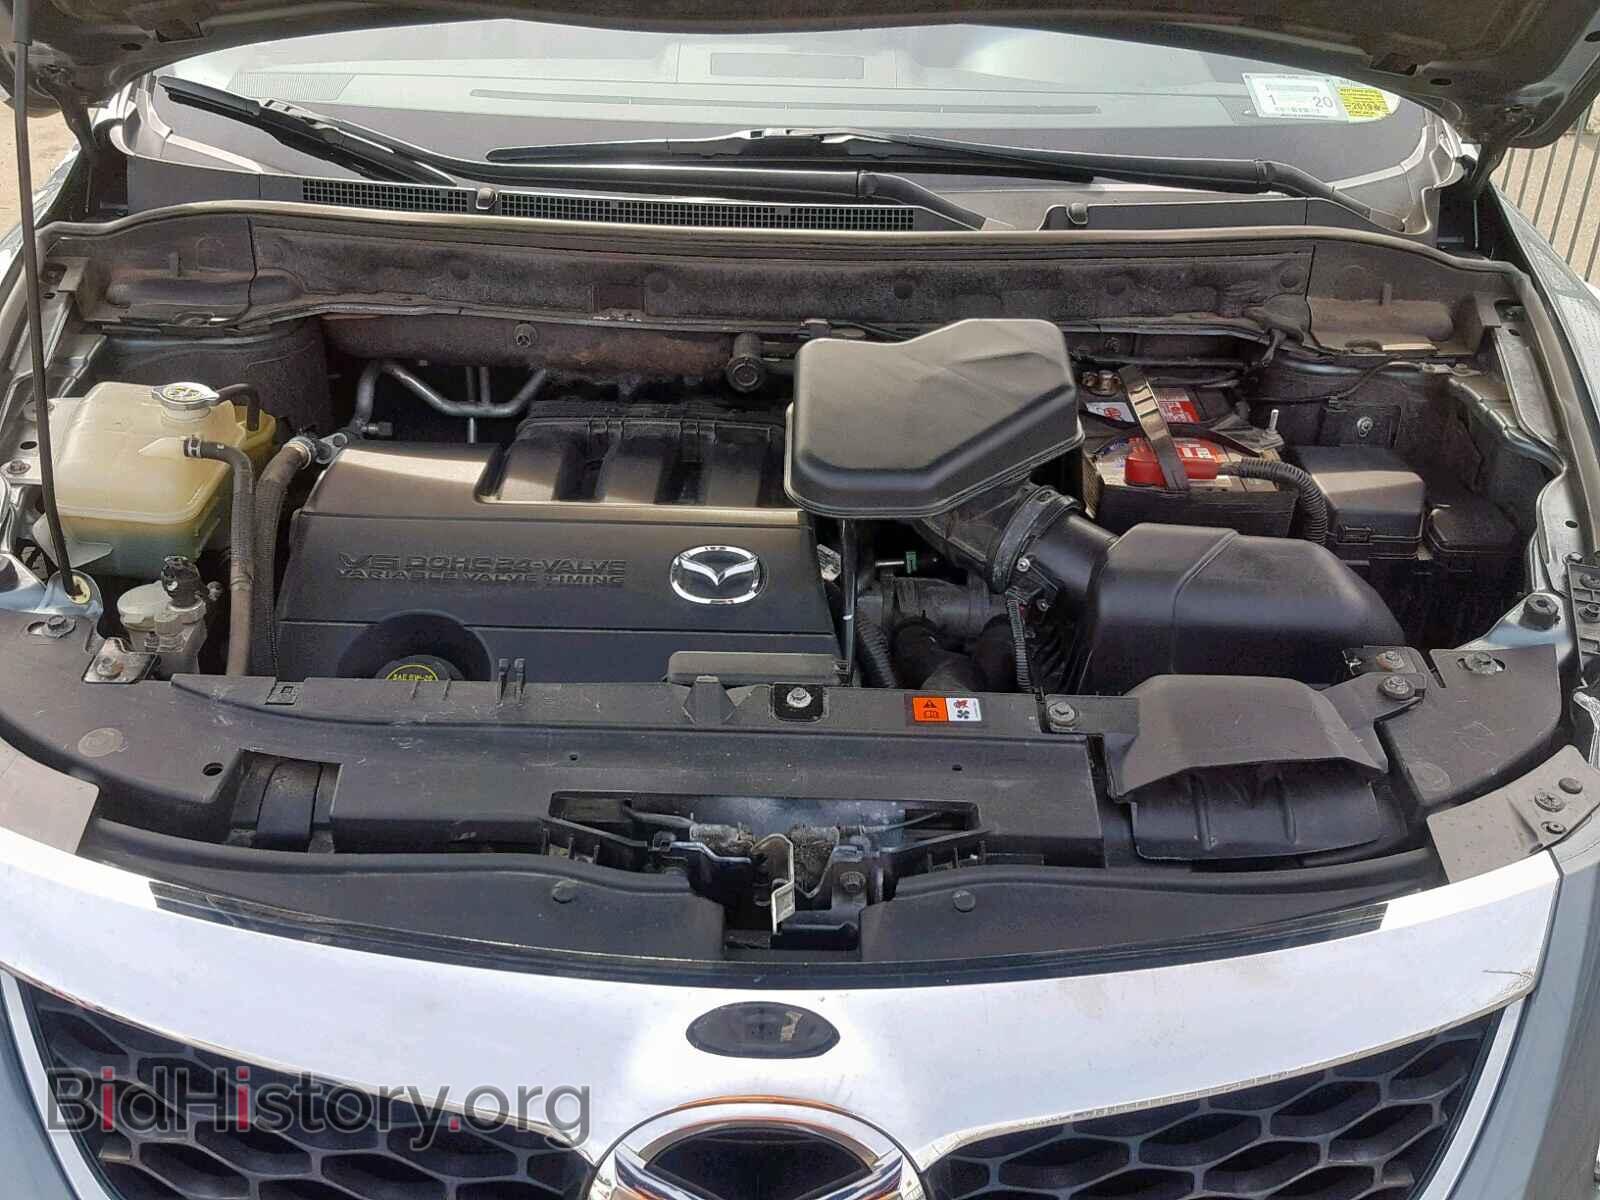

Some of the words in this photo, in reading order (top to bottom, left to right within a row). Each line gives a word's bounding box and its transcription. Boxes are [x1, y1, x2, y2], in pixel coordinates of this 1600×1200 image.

[1313, 96, 1333, 107] 20
[405, 554, 494, 571] DOHC
[336, 567, 458, 582] VARIABLE
[461, 571, 537, 583] VALVE
[543, 574, 626, 586] TIMING
